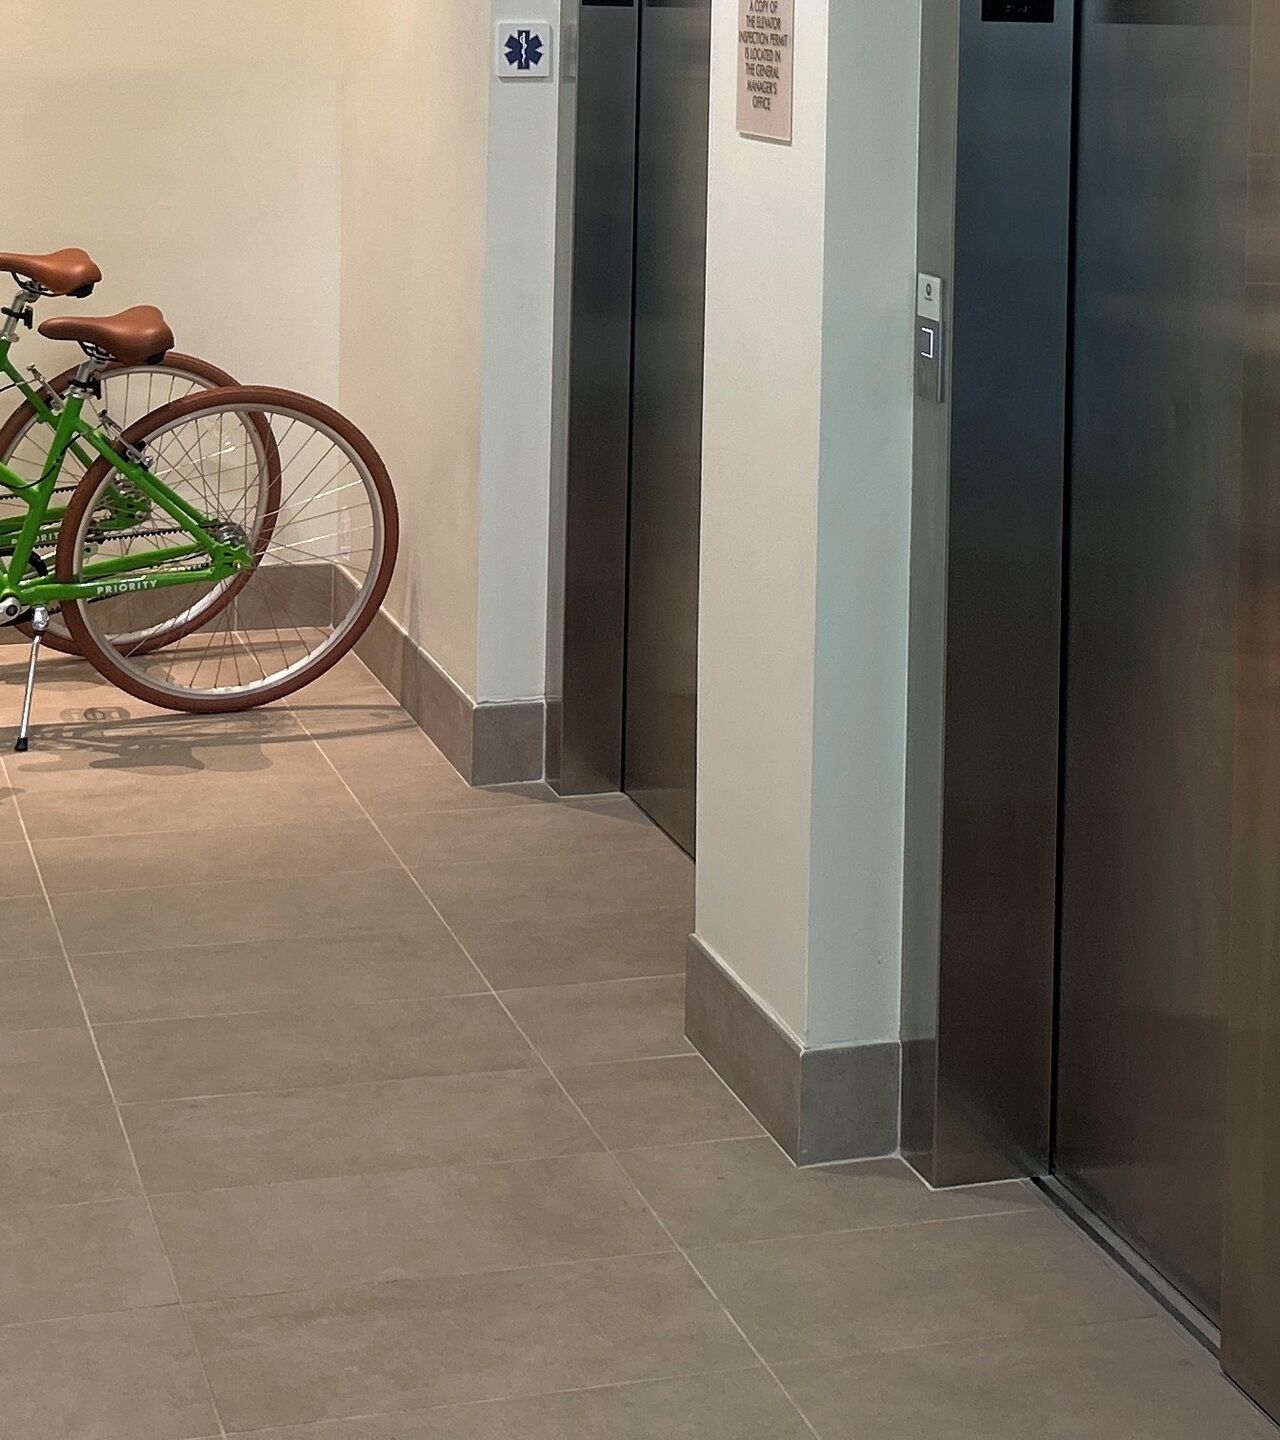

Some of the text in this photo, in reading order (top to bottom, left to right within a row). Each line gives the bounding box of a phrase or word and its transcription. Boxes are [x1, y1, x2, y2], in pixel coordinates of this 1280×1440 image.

[754, 0, 768, 13] COPY
[770, 0, 778, 14] OF
[746, 15, 781, 30] THE ELEVATOR
[739, 30, 769, 45] INSPECTION
[750, 47, 774, 62] LOCATED
[775, 50, 781, 62] IN
[745, 62, 780, 79] THE GENERAL
[747, 80, 777, 95] MANAGER'S
[752, 95, 771, 111] OFFICE
[96, 579, 158, 595] PRIORITY
